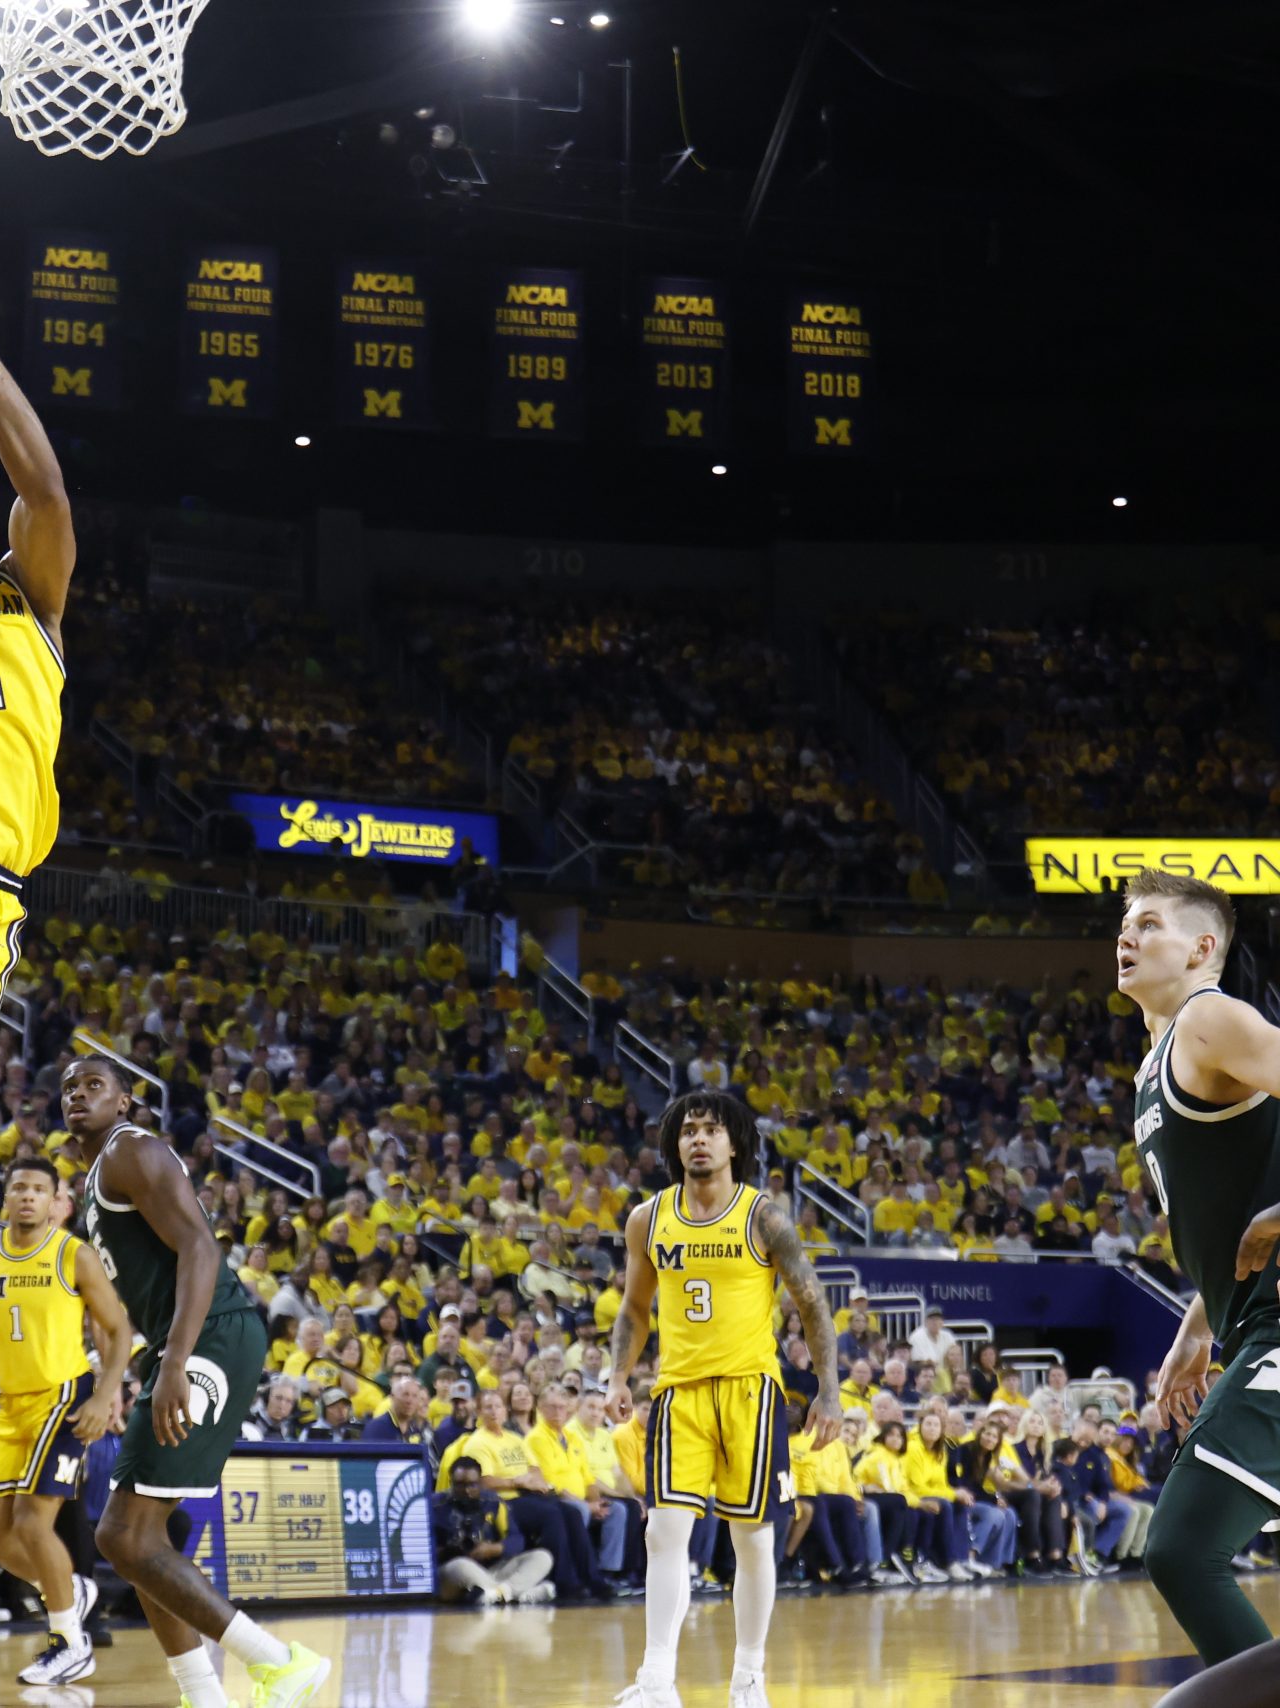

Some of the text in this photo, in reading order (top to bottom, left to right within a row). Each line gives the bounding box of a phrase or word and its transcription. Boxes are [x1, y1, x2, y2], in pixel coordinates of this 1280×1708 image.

[43, 247, 109, 271] NCAA
[198, 259, 263, 283] NCAA
[32, 271, 118, 292] FINAL FOUR
[186, 283, 272, 305] FINAL FOUR
[352, 272, 415, 295] NCAA
[341, 295, 425, 316] FINAL FOUR
[506, 284, 569, 308] NCAA
[653, 294, 716, 317] NCAA
[495, 308, 578, 328] FINAL FOUR
[643, 317, 726, 337] FINAL FOUR
[801, 303, 862, 325] NCAA
[42, 318, 105, 347] 1964
[198, 330, 260, 358] 1965
[791, 325, 871, 346] FINAL FOUR
[353, 341, 413, 370] 1976
[507, 353, 567, 381] 1989
[51, 366, 93, 397] M
[656, 362, 714, 390] 2013
[804, 371, 861, 398] 2018
[207, 377, 248, 408] M
[363, 388, 403, 419] M
[517, 400, 556, 430] M
[665, 407, 704, 438] M
[814, 416, 853, 446] M
[523, 546, 586, 577] 210
[351, 814, 455, 857] JEWELERS
[1042, 852, 1280, 881] NISSAN
[655, 1242, 743, 1270] MICHIGAN
[683, 1278, 713, 1323] 3
[931, 1284, 992, 1302] TUNNEL
[9, 1304, 24, 1342] 1
[53, 1453, 80, 1484] M
[776, 1471, 796, 1503] M
[229, 1488, 375, 1525] 37 38
[286, 1518, 323, 1540] 1:57
